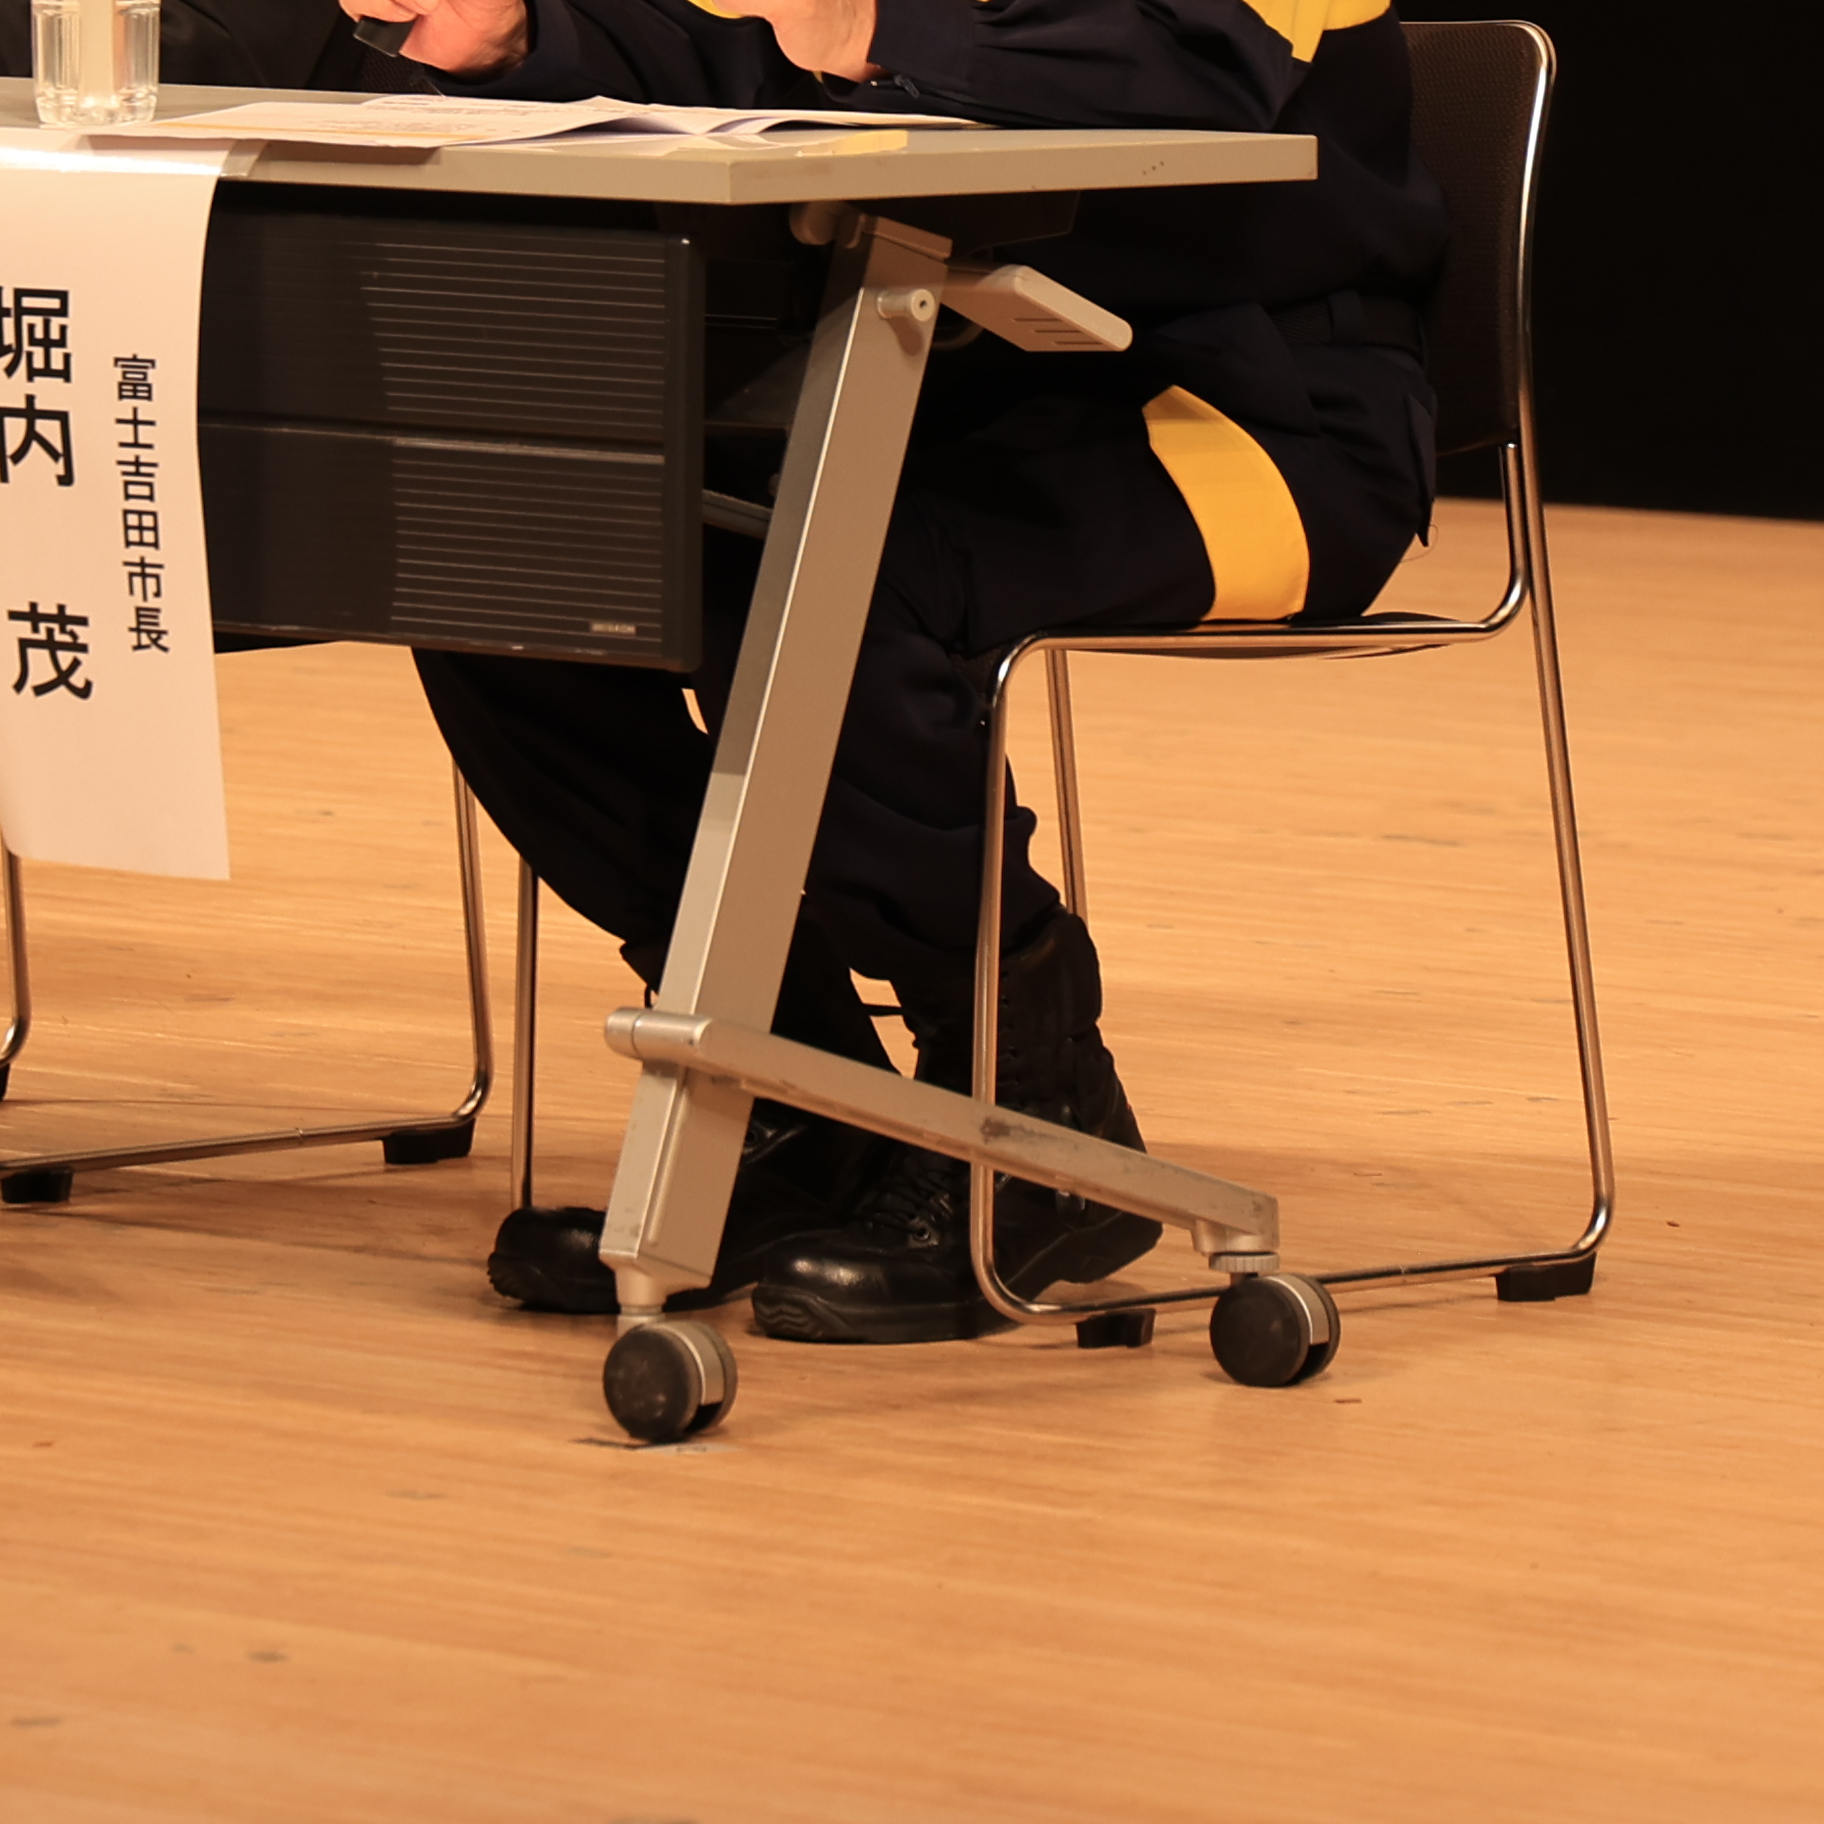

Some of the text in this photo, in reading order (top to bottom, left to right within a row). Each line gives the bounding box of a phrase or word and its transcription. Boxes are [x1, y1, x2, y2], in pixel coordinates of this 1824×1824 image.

[113, 353, 170, 654] 富士吉田市長
[6, 600, 94, 701] 茂
